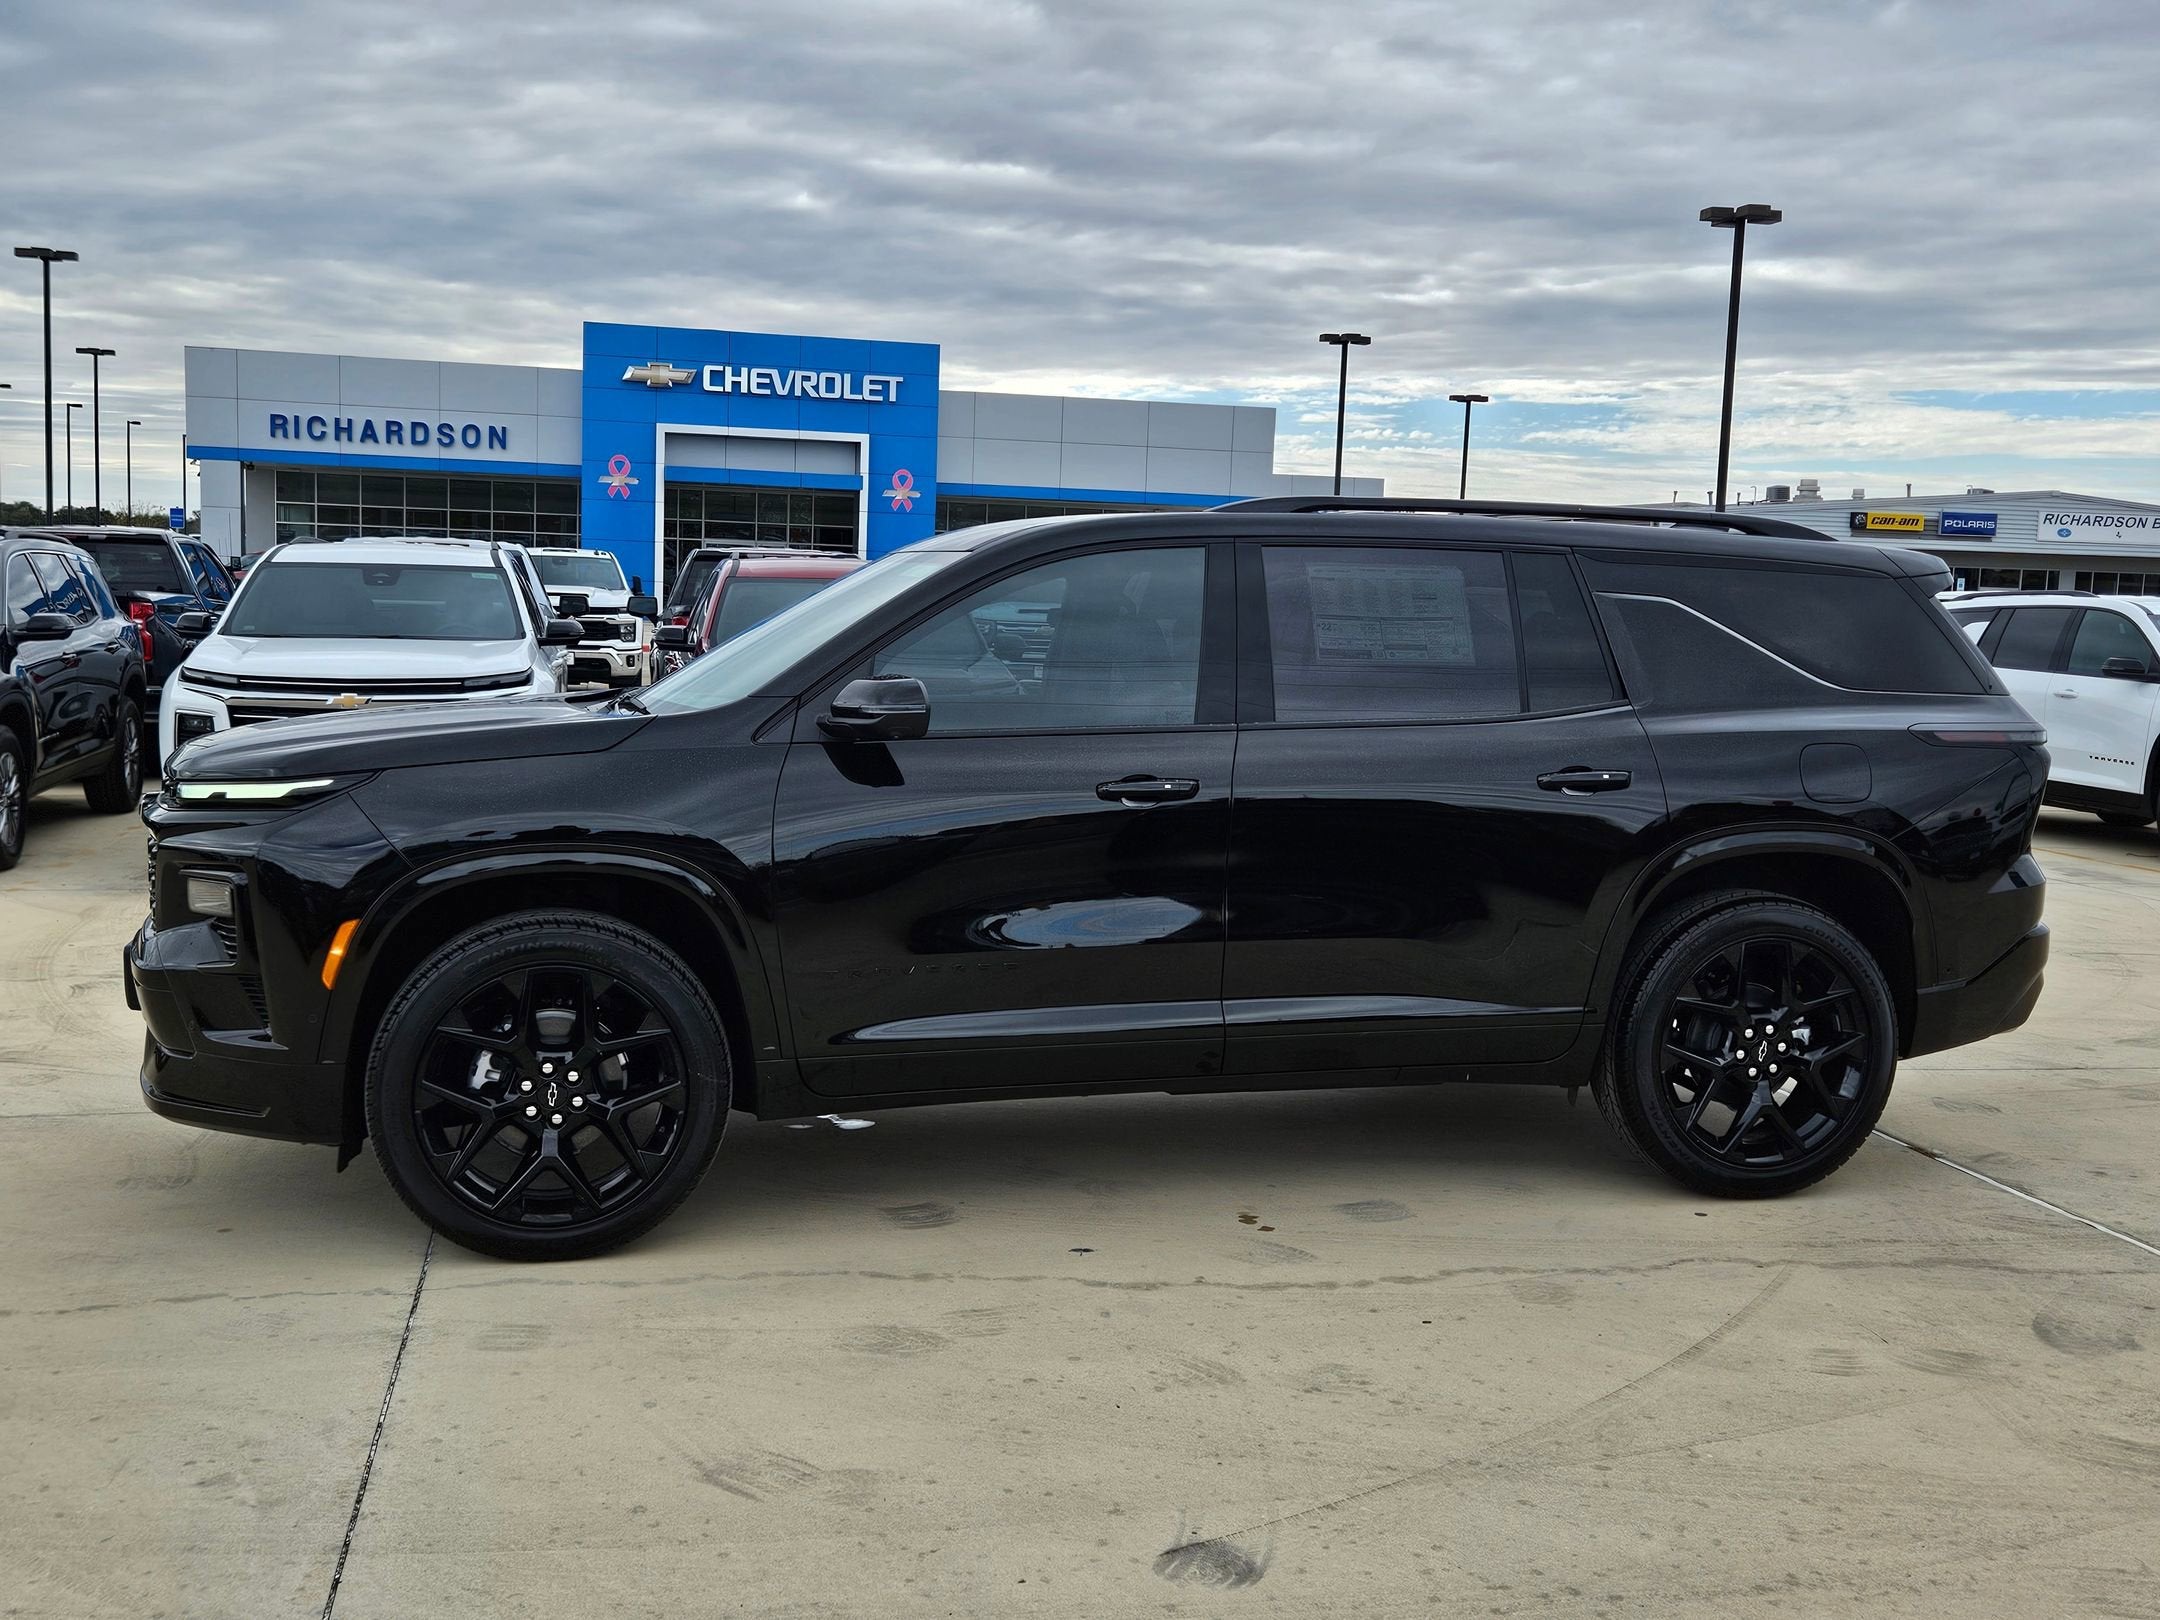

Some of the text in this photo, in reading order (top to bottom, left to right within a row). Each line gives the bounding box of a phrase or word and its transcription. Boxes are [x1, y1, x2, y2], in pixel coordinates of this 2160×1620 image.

[702, 364, 904, 402] CHEVROLET
[269, 413, 509, 450] RICHARDSON
[1870, 515, 1921, 527] can-am
[1944, 519, 1996, 530] POLARIS
[2043, 513, 2149, 529] RICHARDSON
